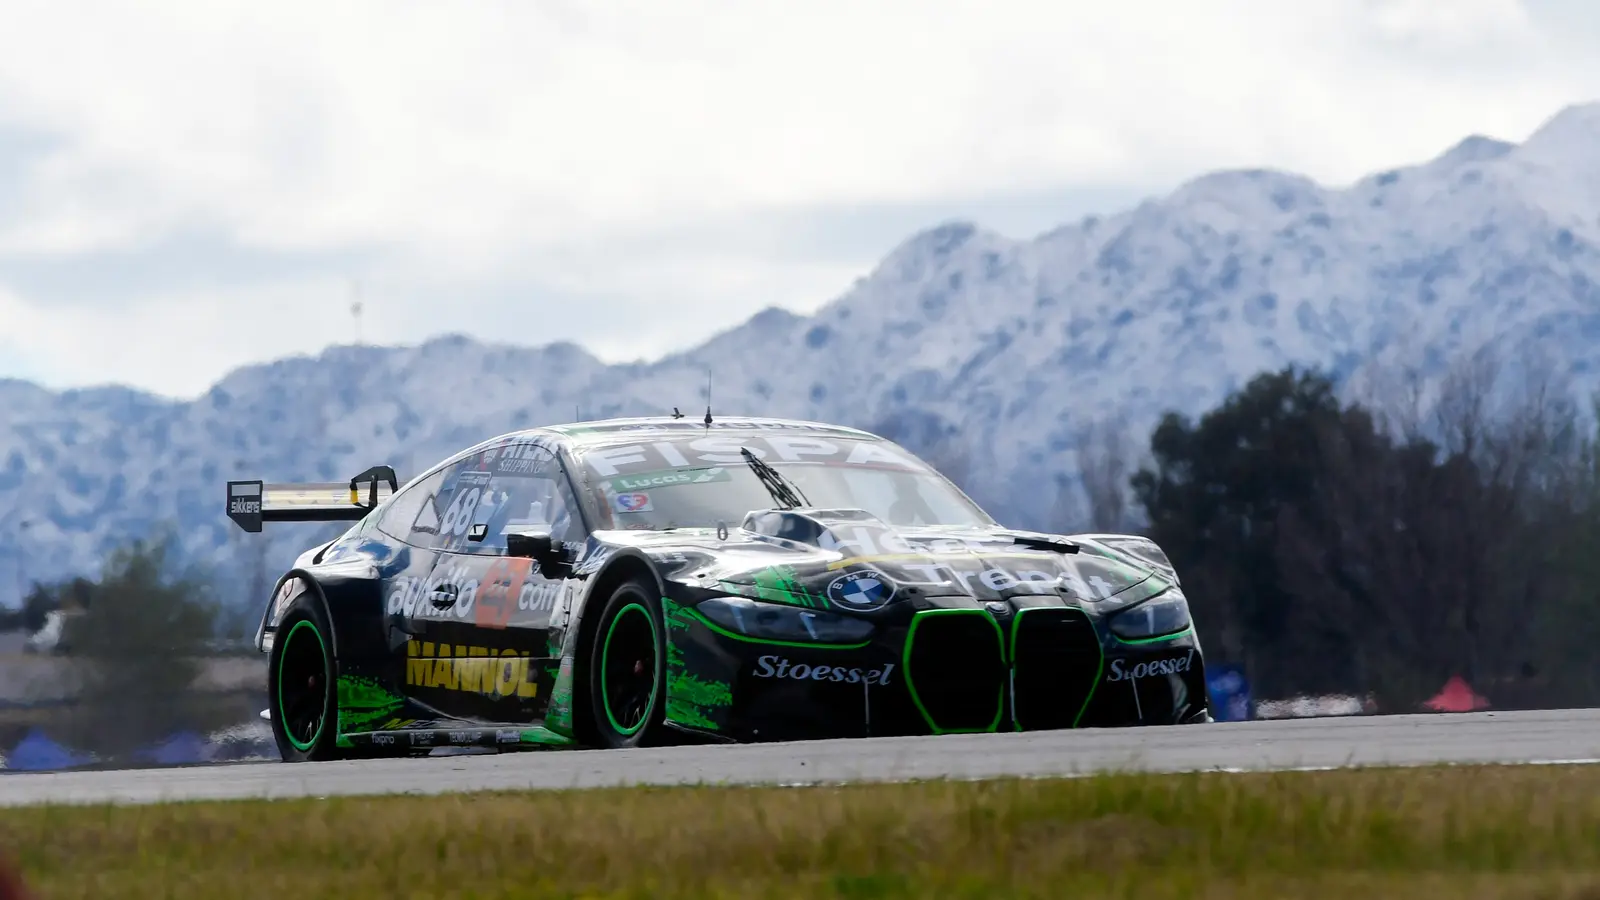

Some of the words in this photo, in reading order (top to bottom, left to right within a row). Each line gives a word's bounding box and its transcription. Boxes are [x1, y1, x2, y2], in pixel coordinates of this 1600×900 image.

[498, 460, 541, 473] SHIPPING
[585, 436, 921, 477] FISPA
[620, 473, 691, 489] Lucas
[231, 497, 260, 513] sikkens
[440, 487, 480, 536] 68
[833, 570, 879, 590] BMW
[407, 640, 537, 697] MANNOL
[752, 655, 895, 686] Stoessel
